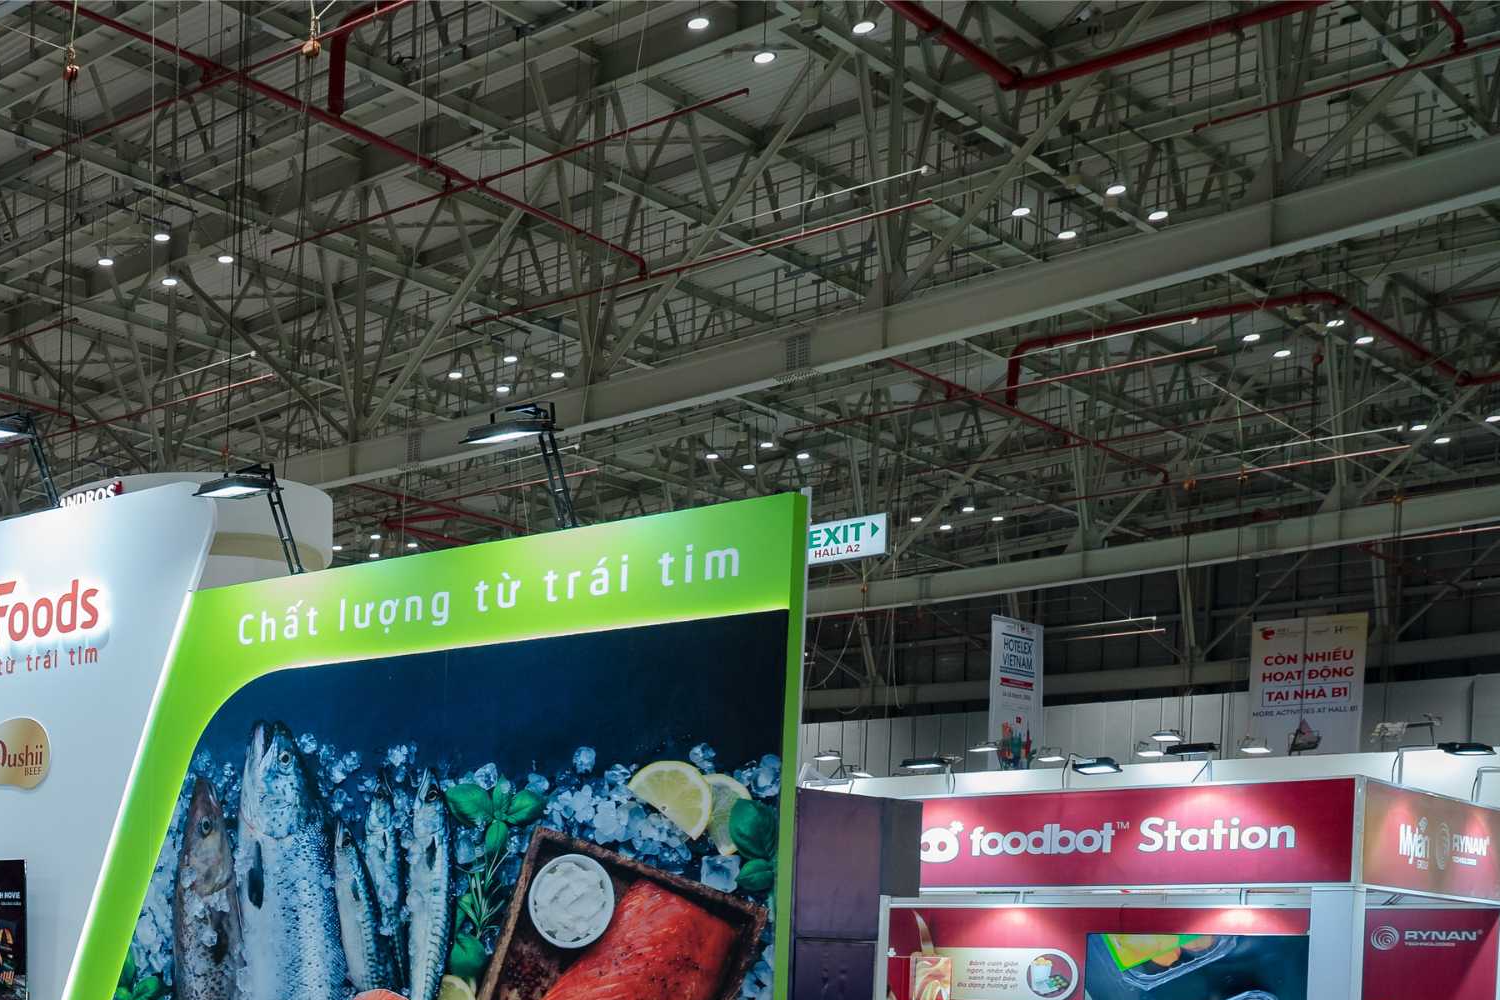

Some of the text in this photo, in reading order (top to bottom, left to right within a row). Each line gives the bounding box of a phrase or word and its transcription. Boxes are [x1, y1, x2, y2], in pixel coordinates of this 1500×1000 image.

[59, 483, 116, 510] ANDROS
[809, 522, 866, 549] EXIT
[814, 544, 860, 558] HALL A2
[238, 543, 740, 646] Chất lượng từ trái tim
[1003, 638, 1032, 656] HOTELEX
[27, 650, 58, 673] trái
[69, 645, 99, 667] tim
[1002, 652, 1033, 670] VIETNAM
[1264, 652, 1298, 666] CÒN
[1262, 666, 1354, 684] HOẠT ĐỘNG
[1266, 686, 1348, 704] TẠI NHÀ B1
[24, 767, 43, 777] BEEF
[1138, 817, 1295, 853] Station
